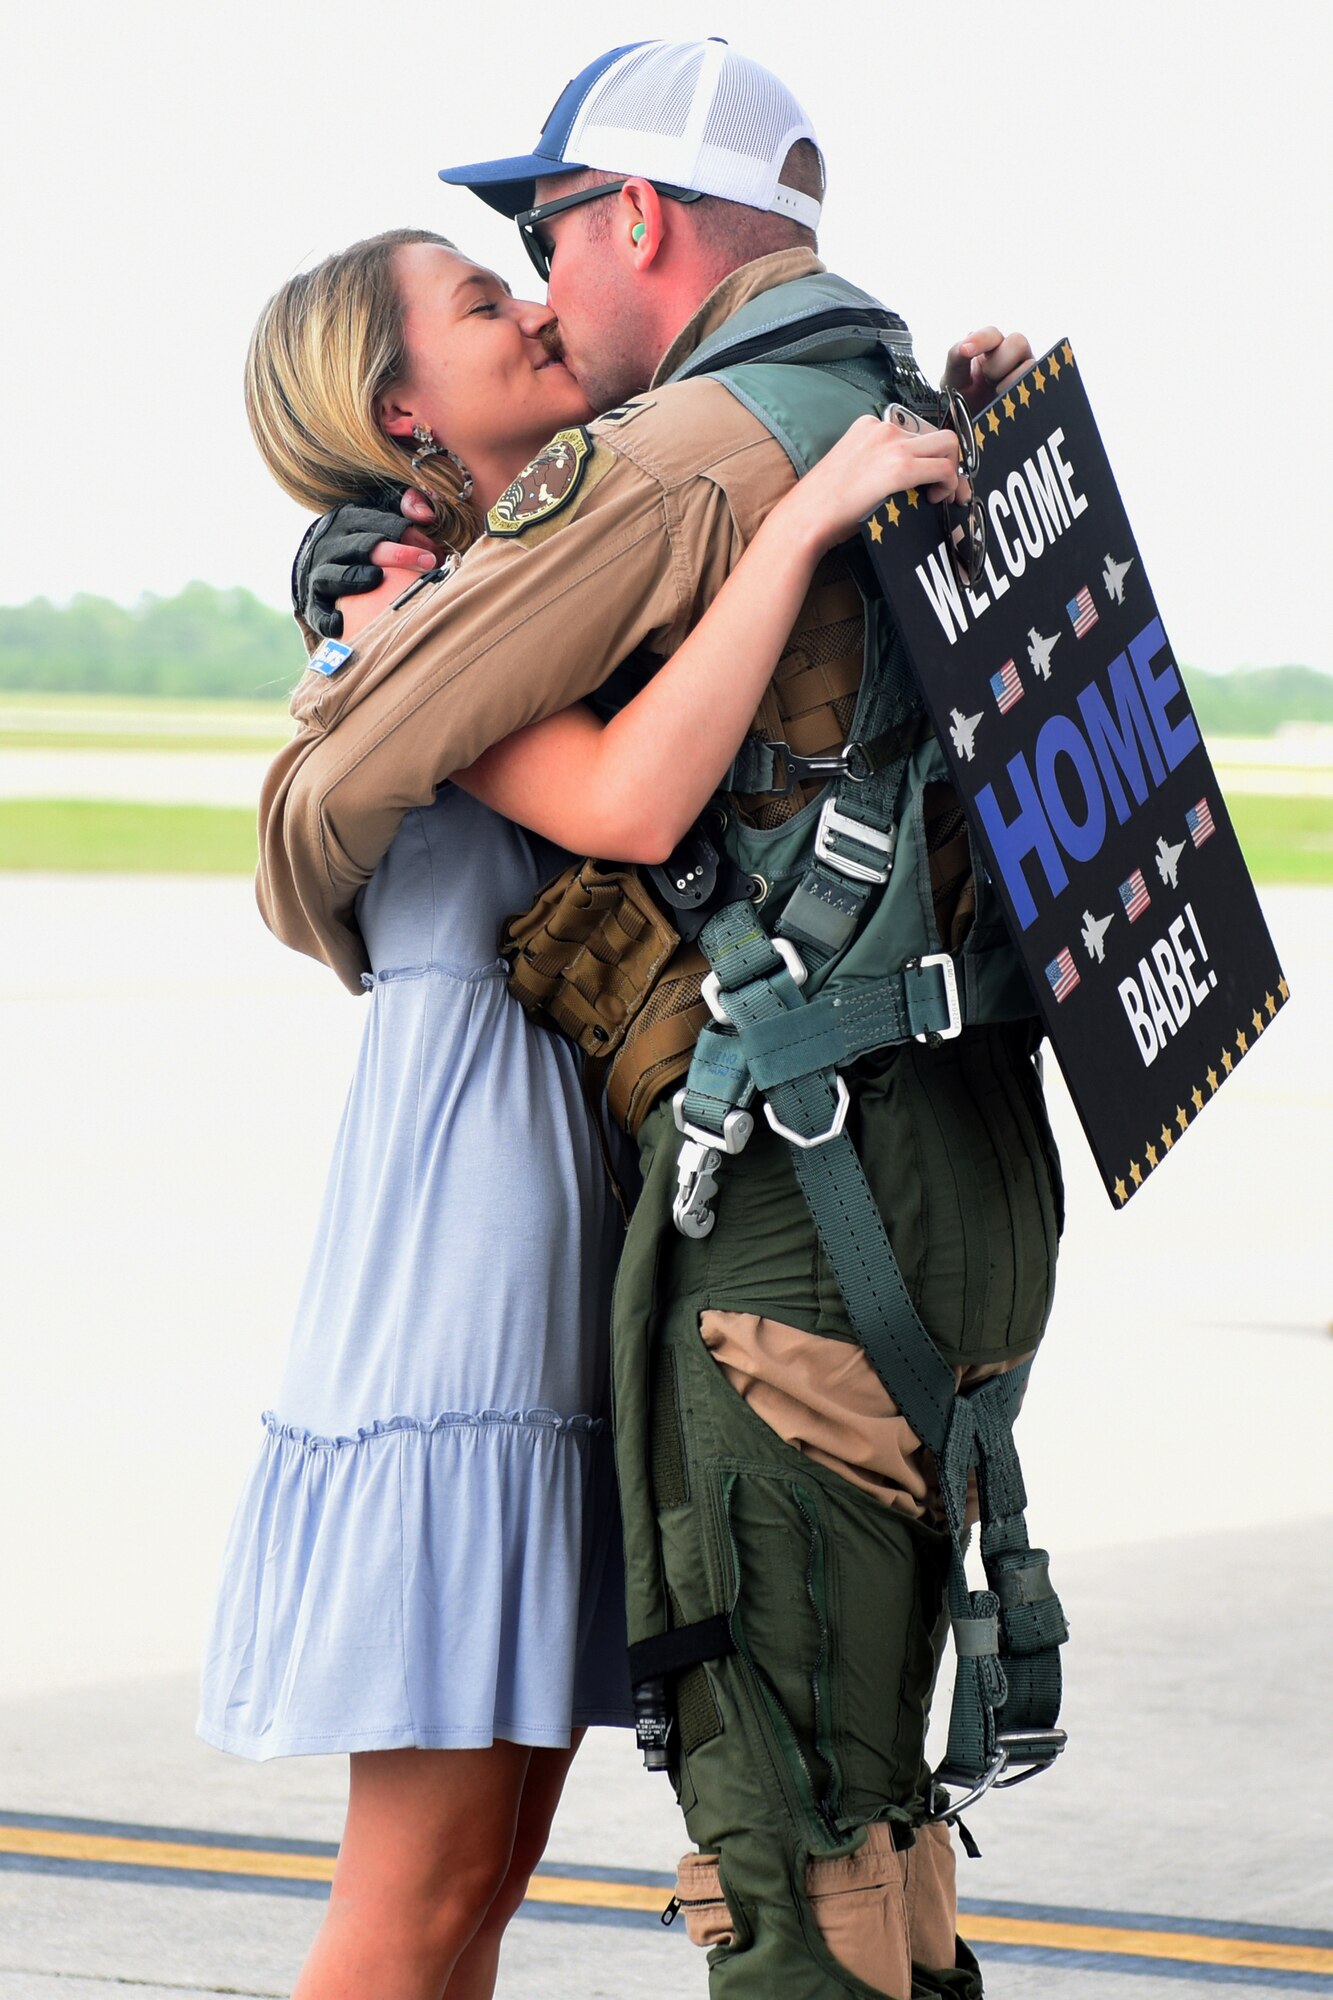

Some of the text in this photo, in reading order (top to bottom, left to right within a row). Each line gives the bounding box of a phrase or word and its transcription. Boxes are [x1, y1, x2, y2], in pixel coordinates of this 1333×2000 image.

[915, 427, 1089, 645] WELCOME
[974, 615, 1200, 931] HOME
[1117, 902, 1218, 1067] BABE!
